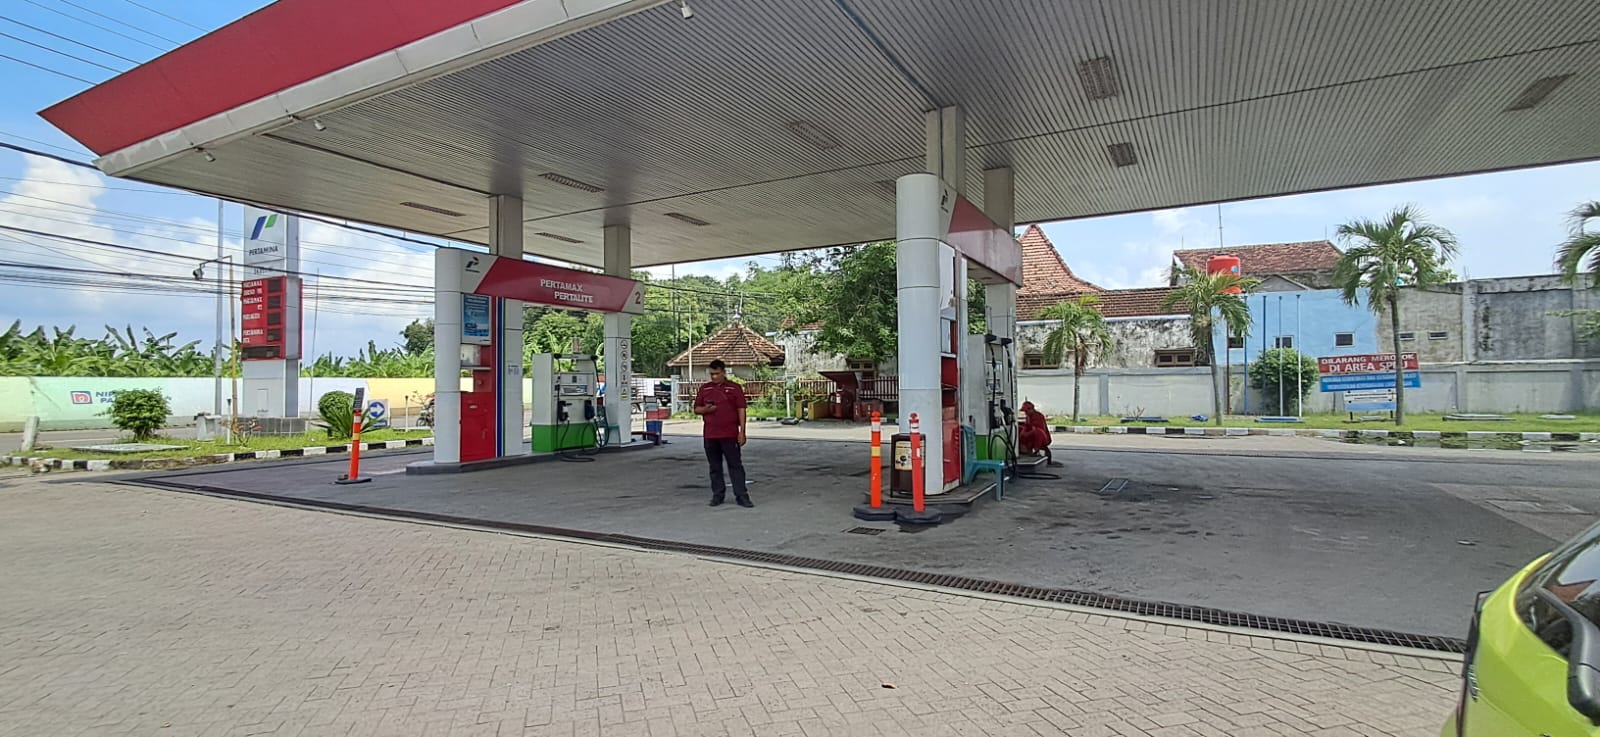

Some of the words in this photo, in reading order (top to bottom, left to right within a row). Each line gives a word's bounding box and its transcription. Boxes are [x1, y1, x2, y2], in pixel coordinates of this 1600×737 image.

[540, 279, 584, 292] PERTAMAX
[554, 291, 593, 303] PERTALITE
[634, 291, 641, 304] 2
[1321, 356, 1367, 365] DILARANG
[1371, 353, 1414, 362] MEROOK
[1329, 364, 1340, 373] DI
[1344, 362, 1375, 372] AREA
